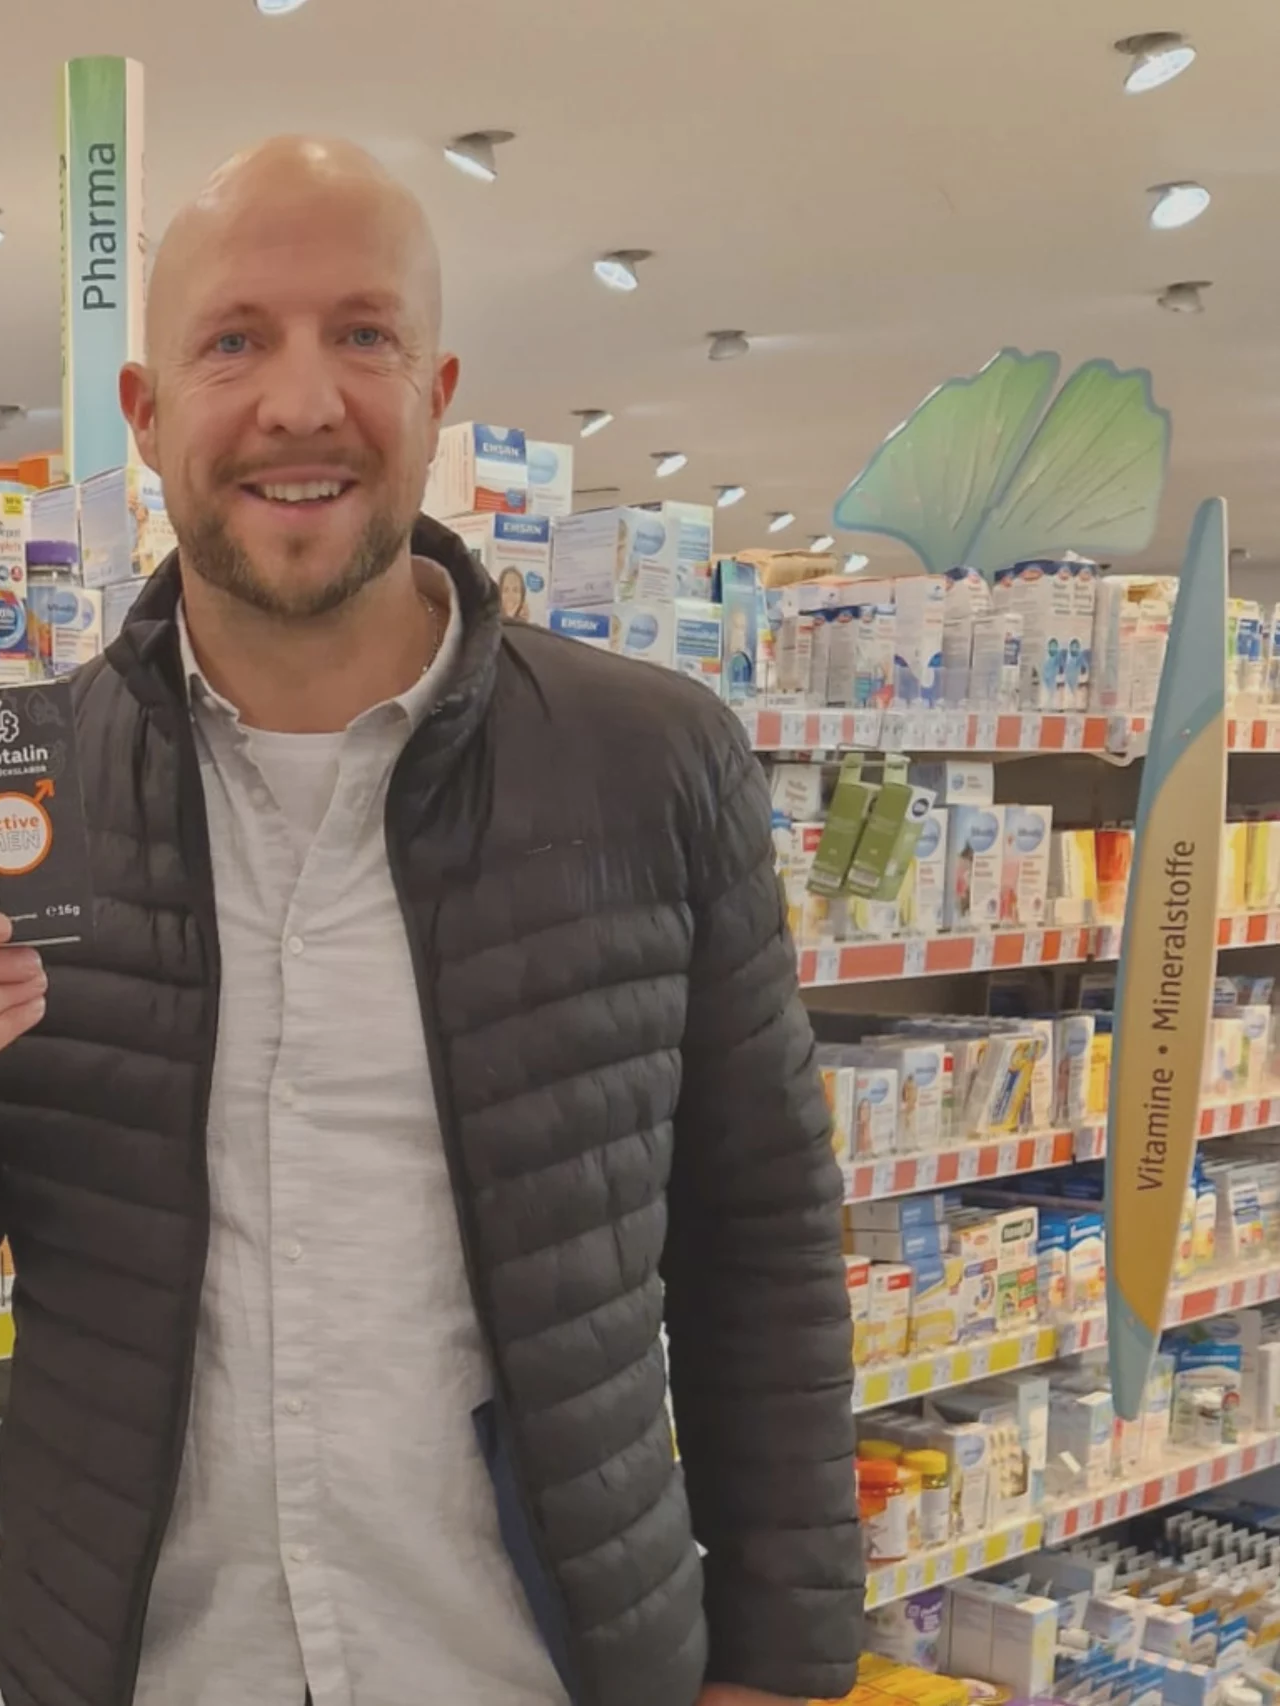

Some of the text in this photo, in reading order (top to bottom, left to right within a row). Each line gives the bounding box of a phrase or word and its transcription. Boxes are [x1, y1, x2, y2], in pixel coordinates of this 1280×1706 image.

[81, 143, 116, 310] Pharma
[1137, 841, 1195, 1192] Vitamine Mineralstoffe
